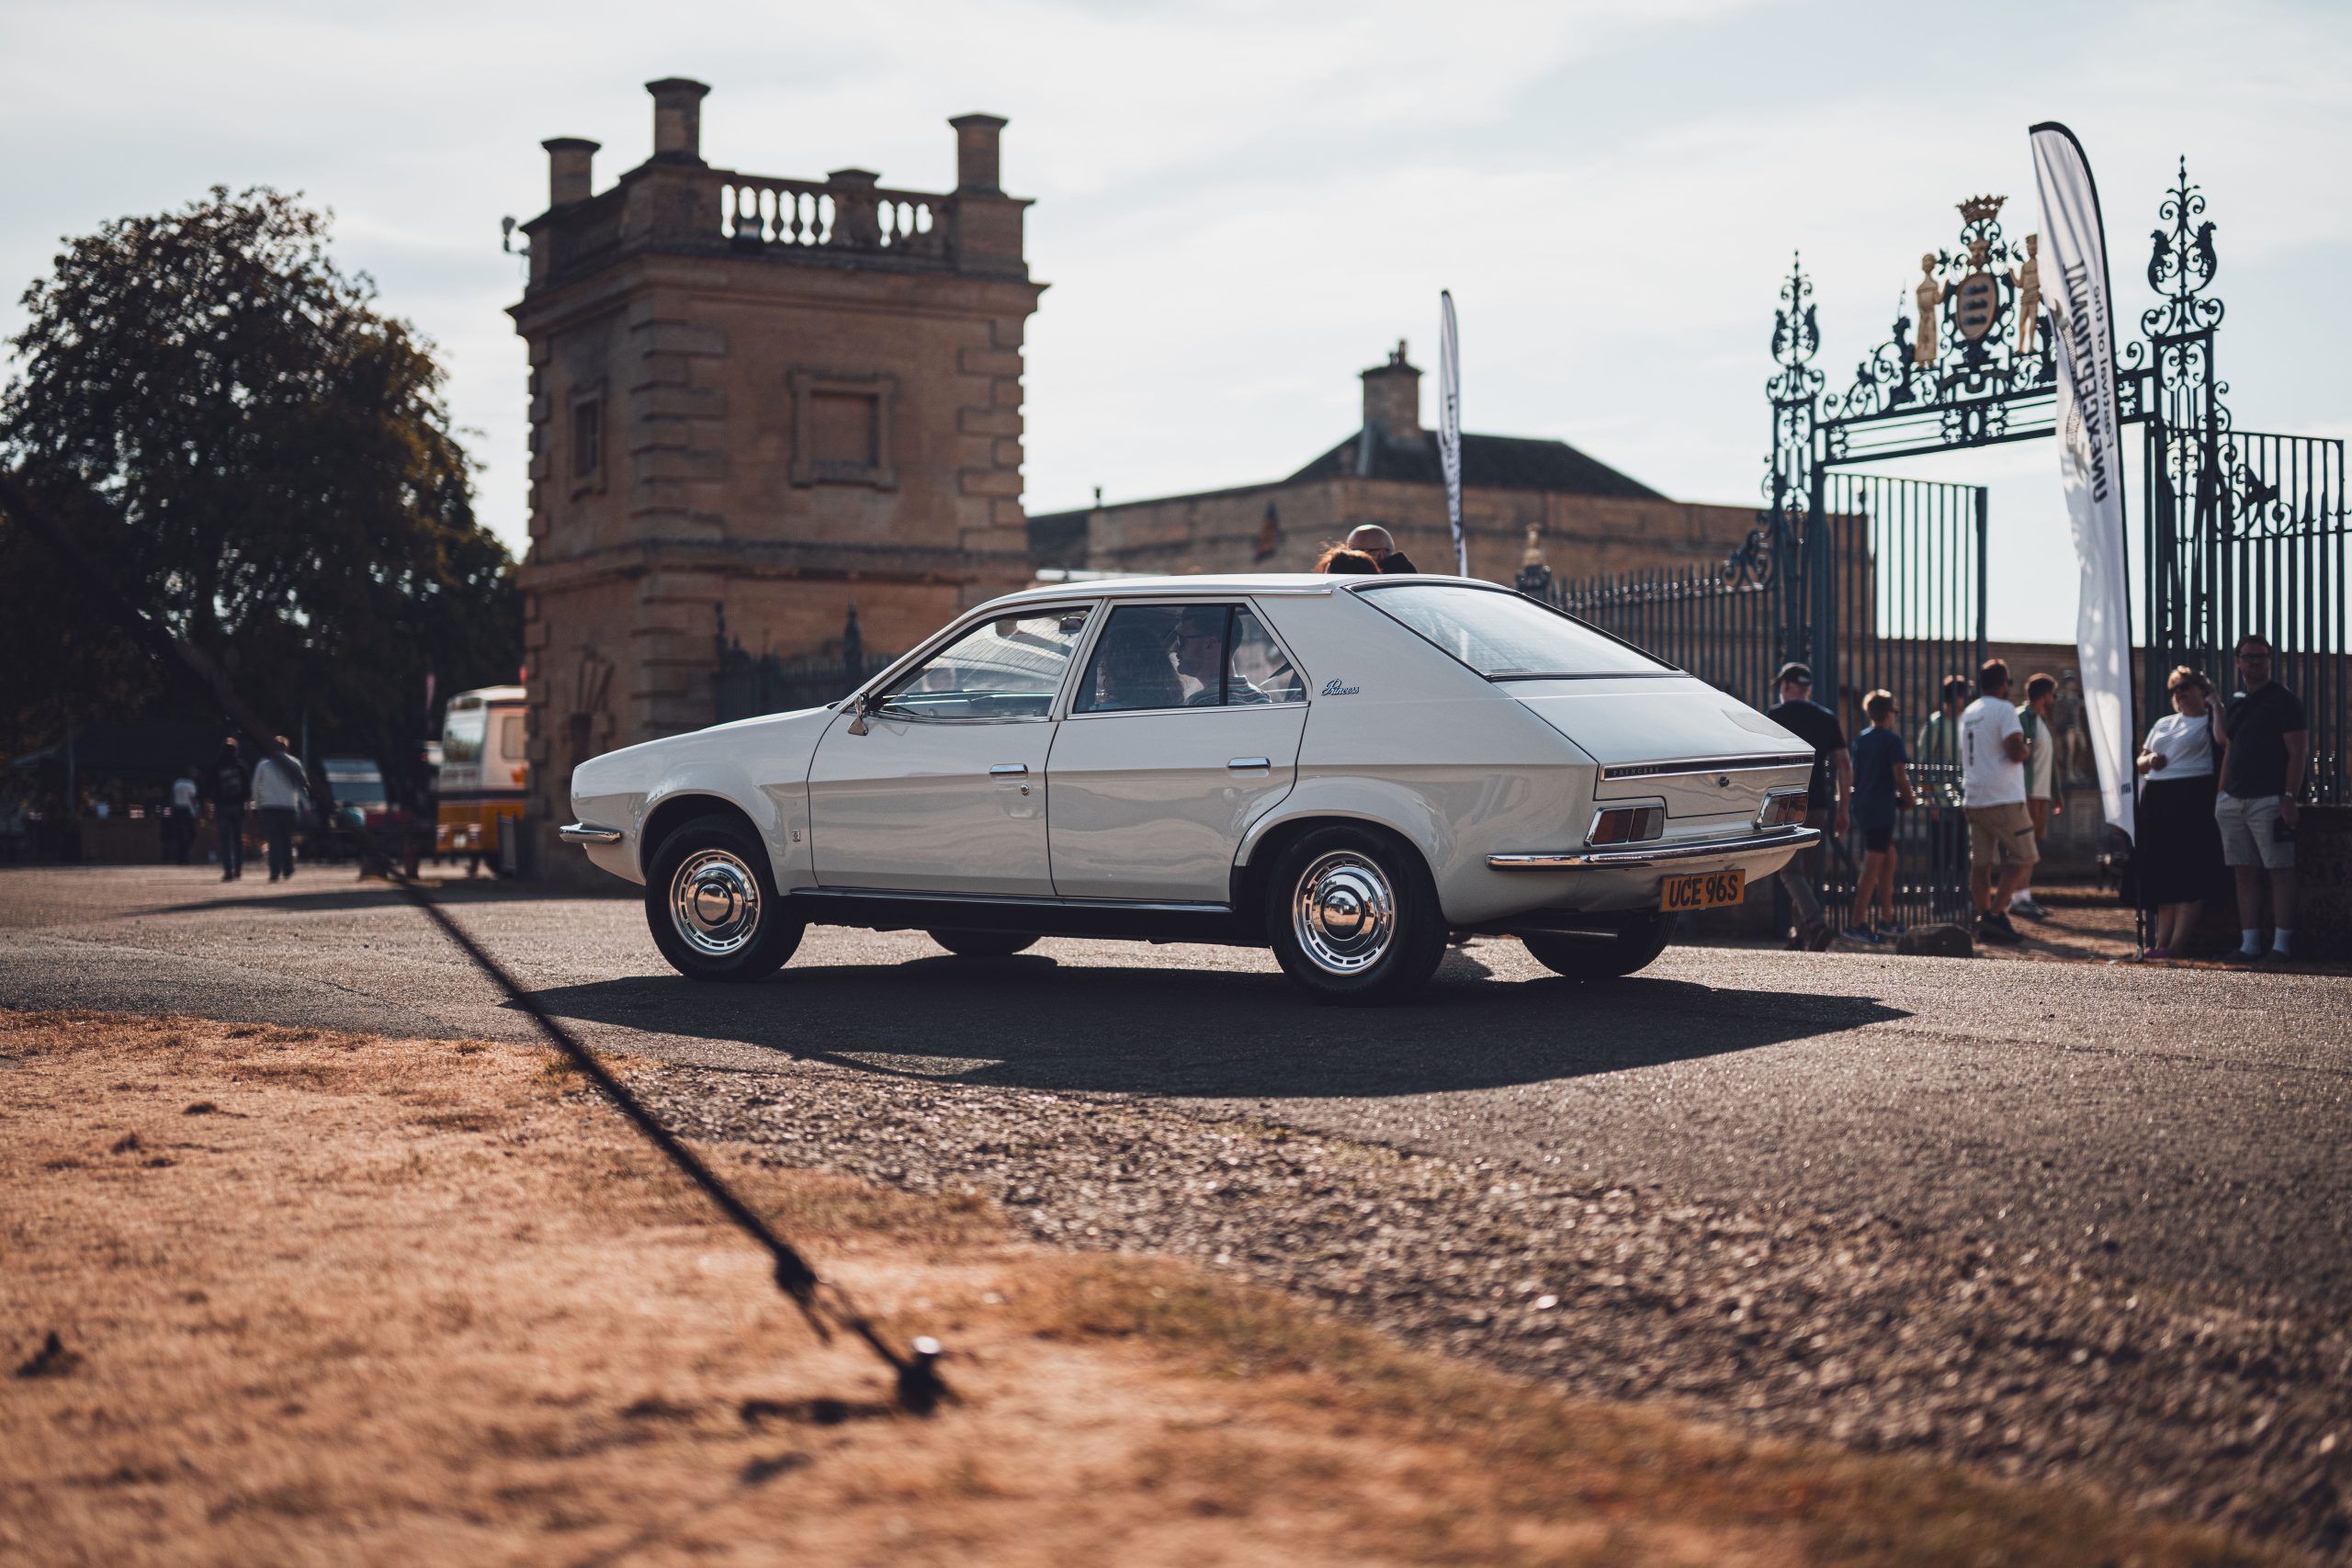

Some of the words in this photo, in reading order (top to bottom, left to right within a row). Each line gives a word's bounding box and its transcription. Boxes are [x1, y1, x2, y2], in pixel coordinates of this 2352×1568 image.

[1321, 679, 1360, 695] Princess
[1668, 877, 1702, 908] UCE
[1706, 874, 1738, 903] 96S
